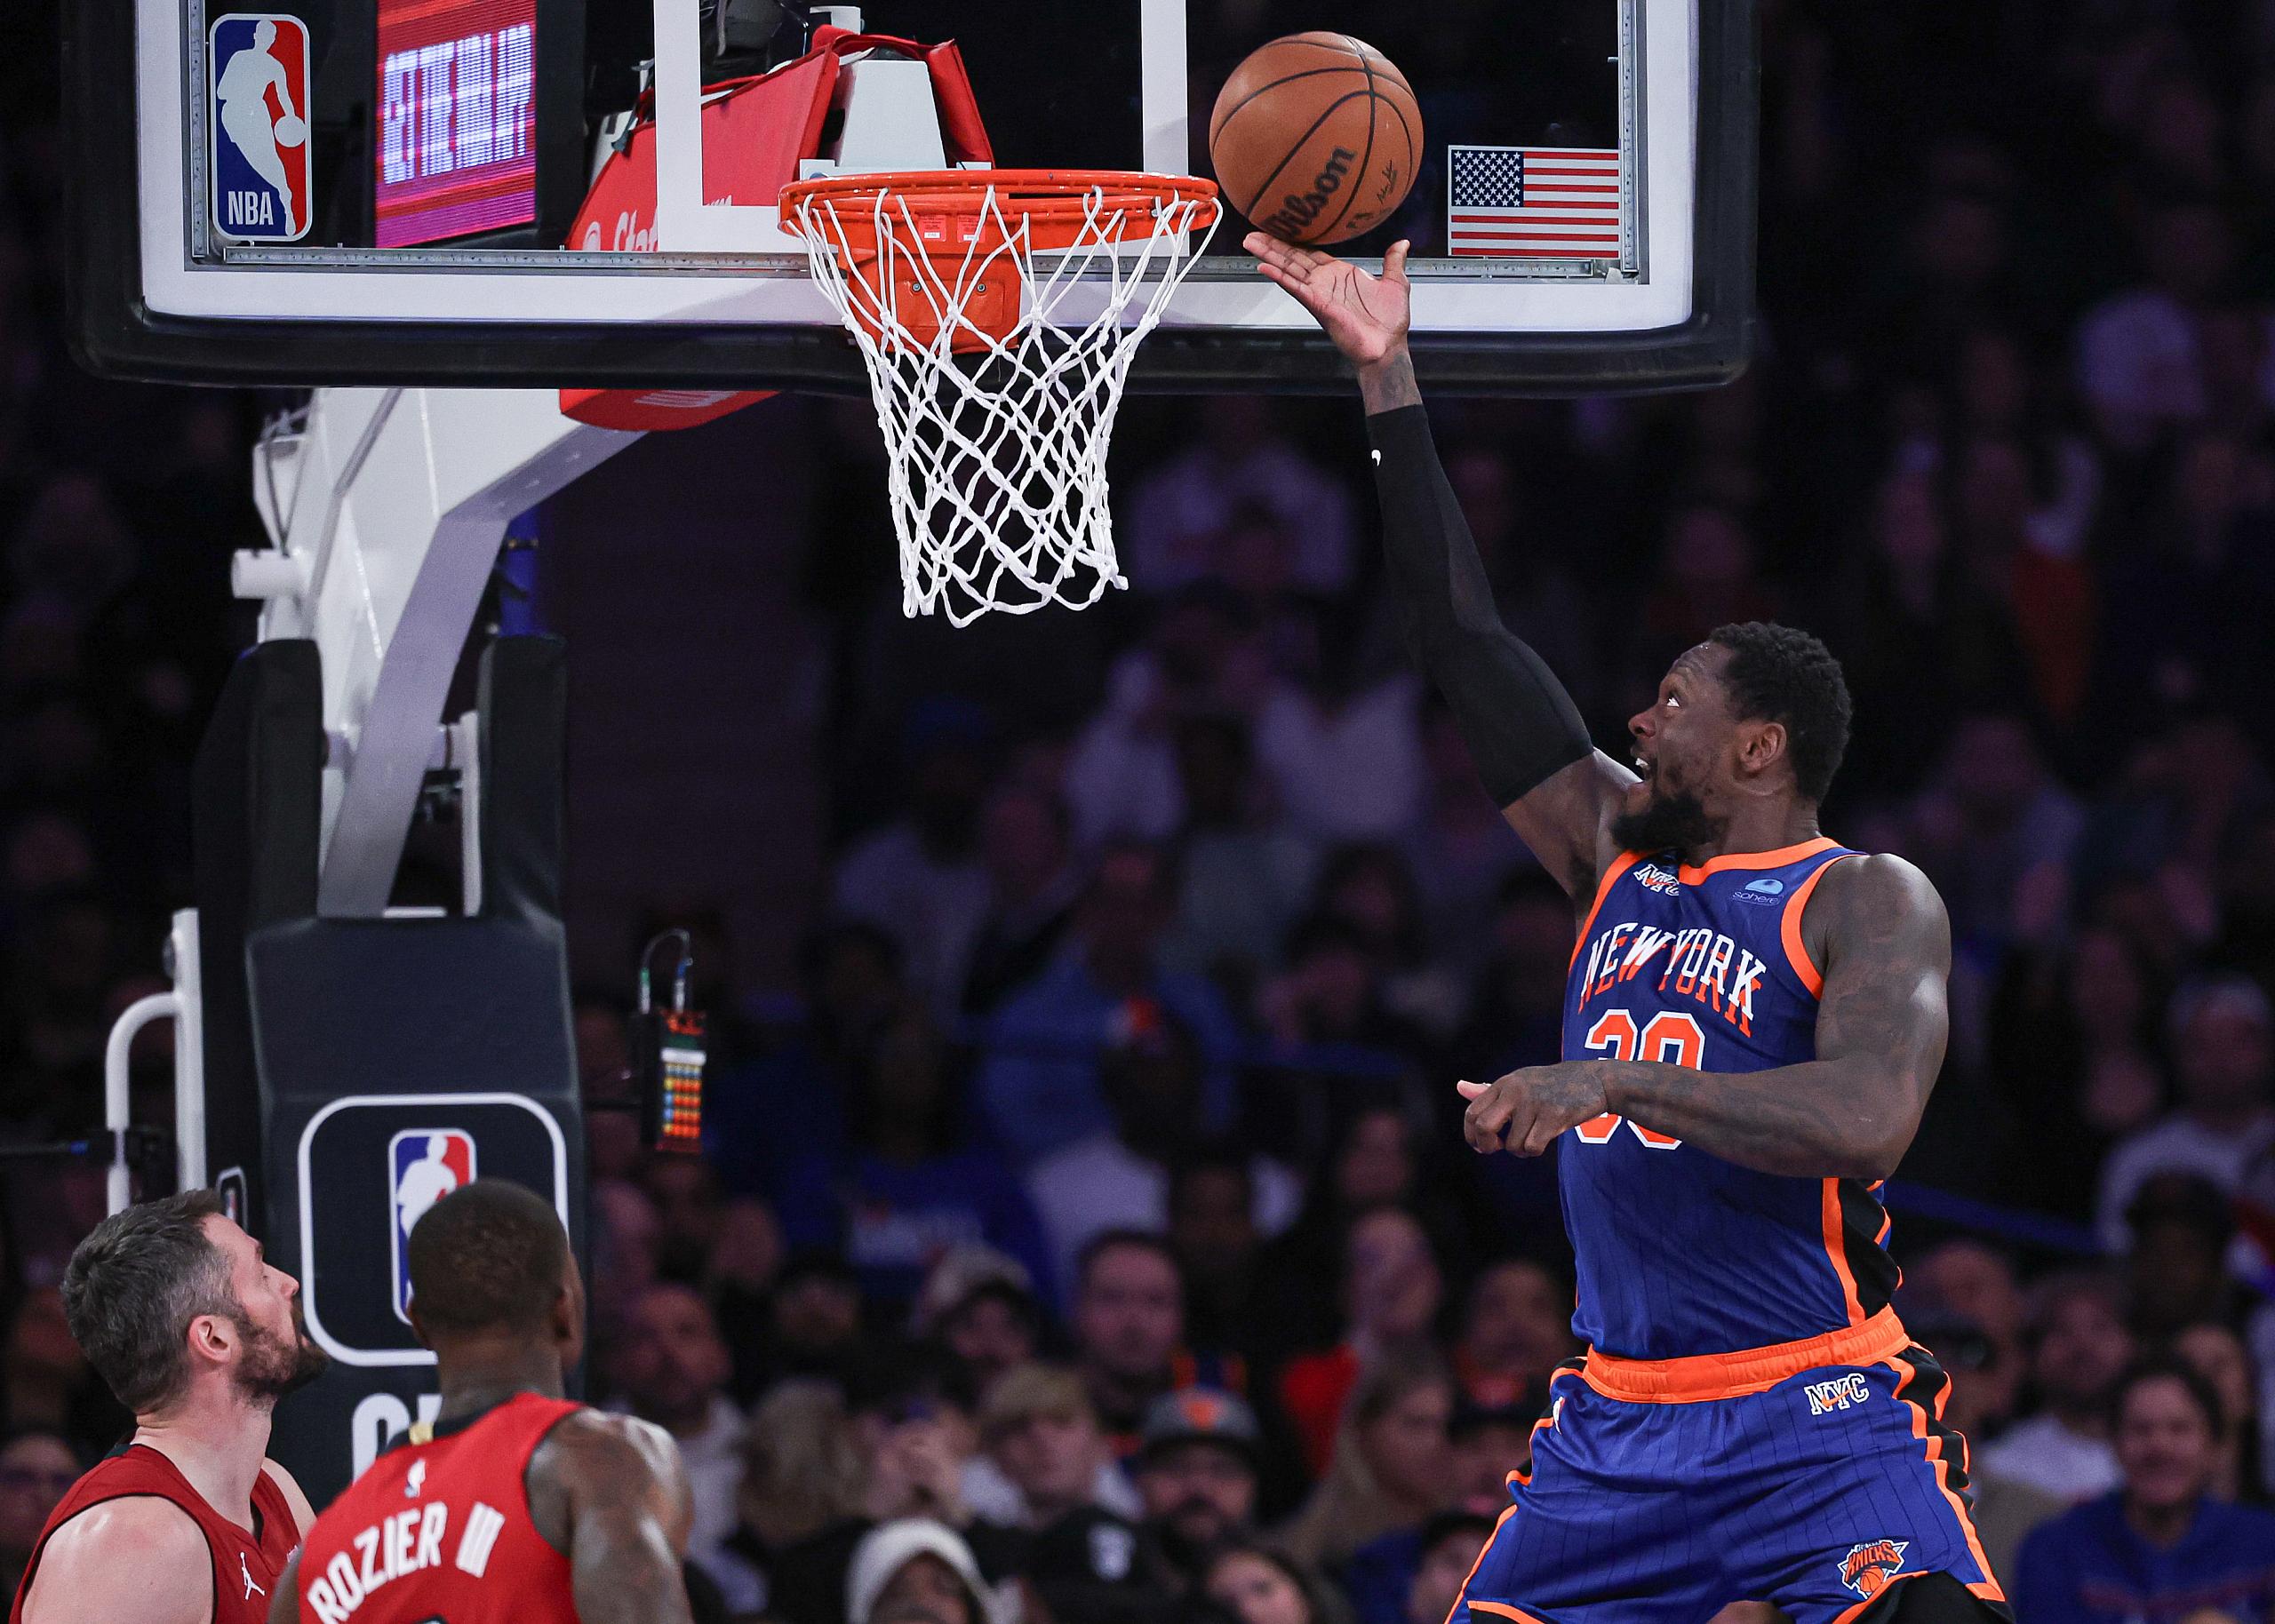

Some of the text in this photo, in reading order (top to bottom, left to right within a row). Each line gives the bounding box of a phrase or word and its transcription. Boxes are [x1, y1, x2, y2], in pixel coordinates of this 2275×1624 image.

[228, 190, 274, 226] NBA
[1578, 922, 1767, 1038] NEW YORK
[1804, 1373, 1870, 1415] NYC
[307, 1501, 506, 1624] ROZIER III
[1845, 1541, 1901, 1582] KNICKS
